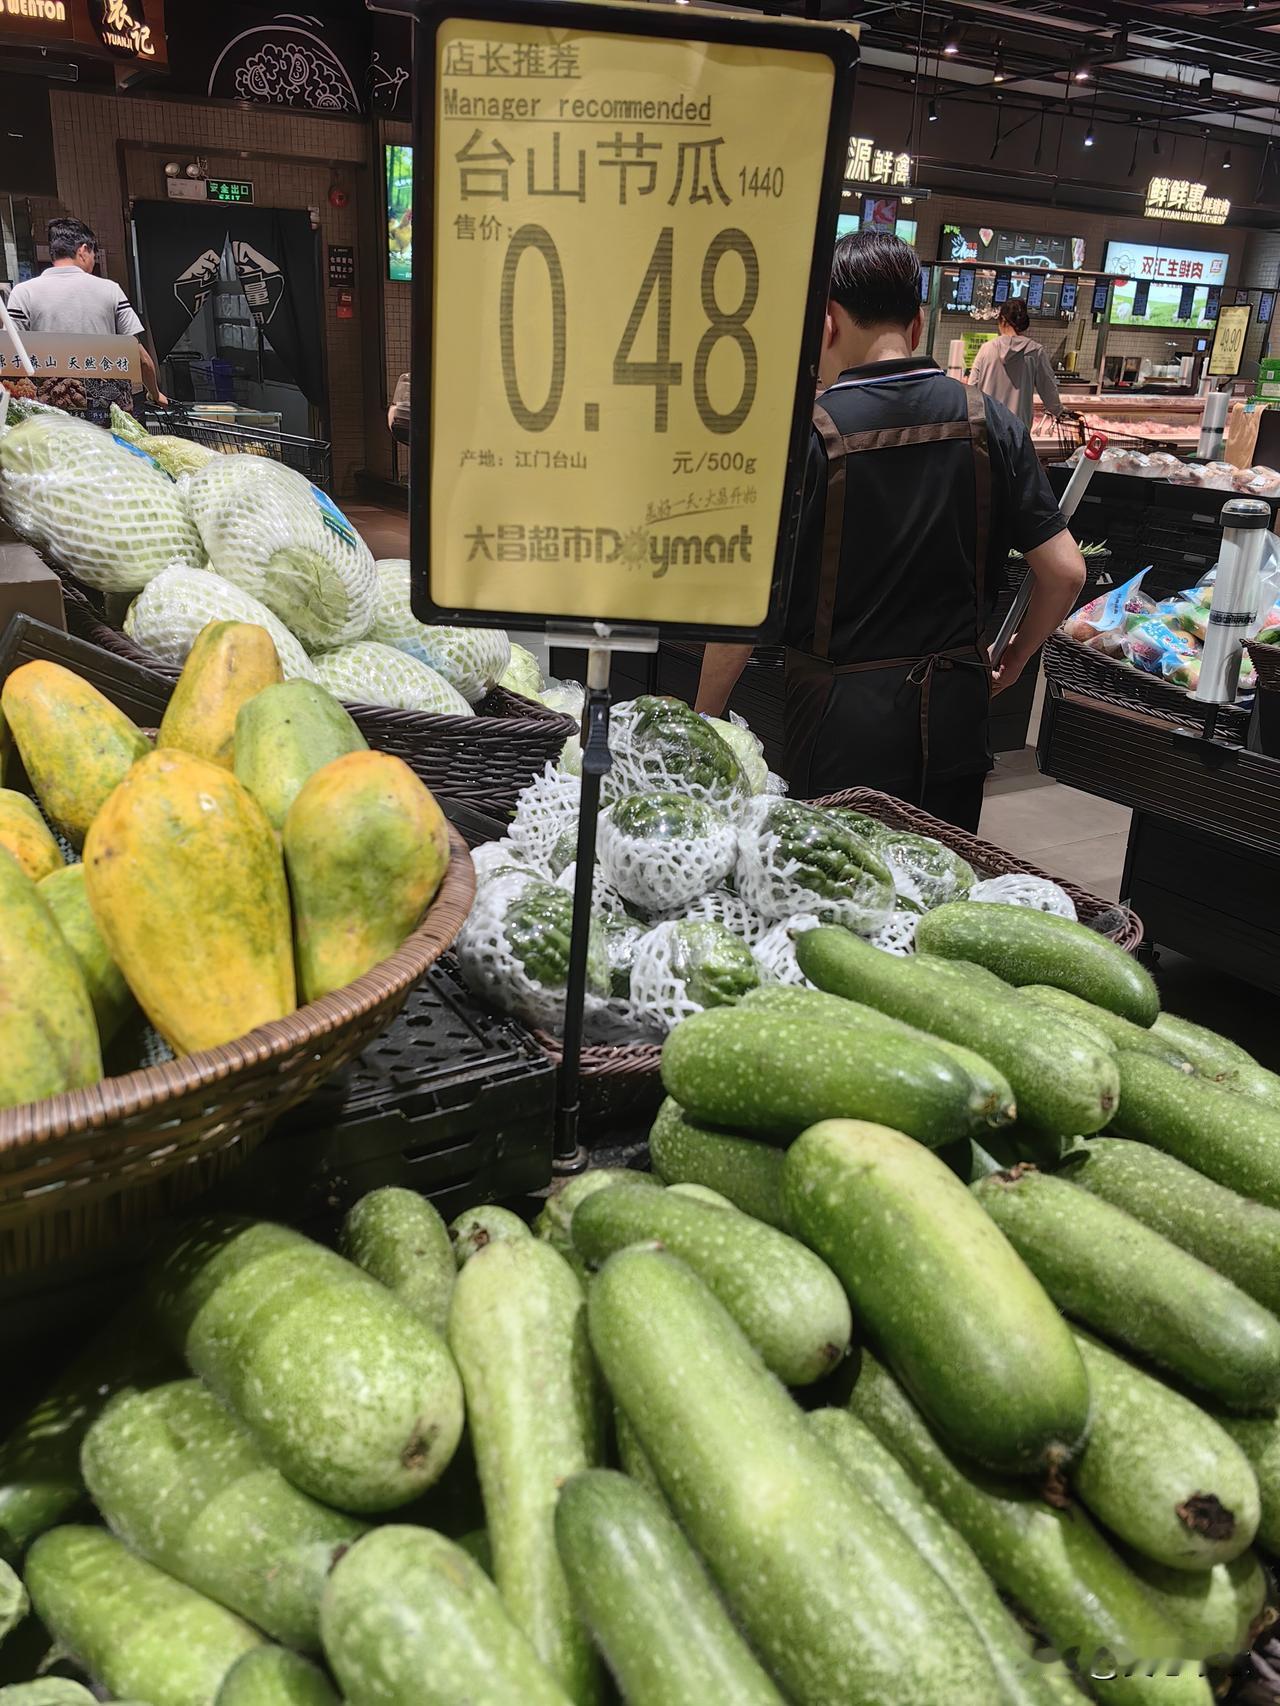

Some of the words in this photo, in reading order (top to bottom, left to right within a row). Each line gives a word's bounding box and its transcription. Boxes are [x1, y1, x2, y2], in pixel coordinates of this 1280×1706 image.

[445, 42, 581, 78] 店长推荐
[444, 88, 541, 120] Manager
[559, 94, 712, 122] recommended
[455, 129, 733, 207] 台山节瓜
[738, 166, 784, 199] 1440
[209, 182, 249, 196] 安全出口
[1140, 256, 1204, 280] 双汇生鲜肉
[500, 223, 759, 435] 0.48
[68, 356, 129, 371] 天然食材
[672, 452, 757, 474] 元/500g
[464, 525, 594, 563] 大昌超市
